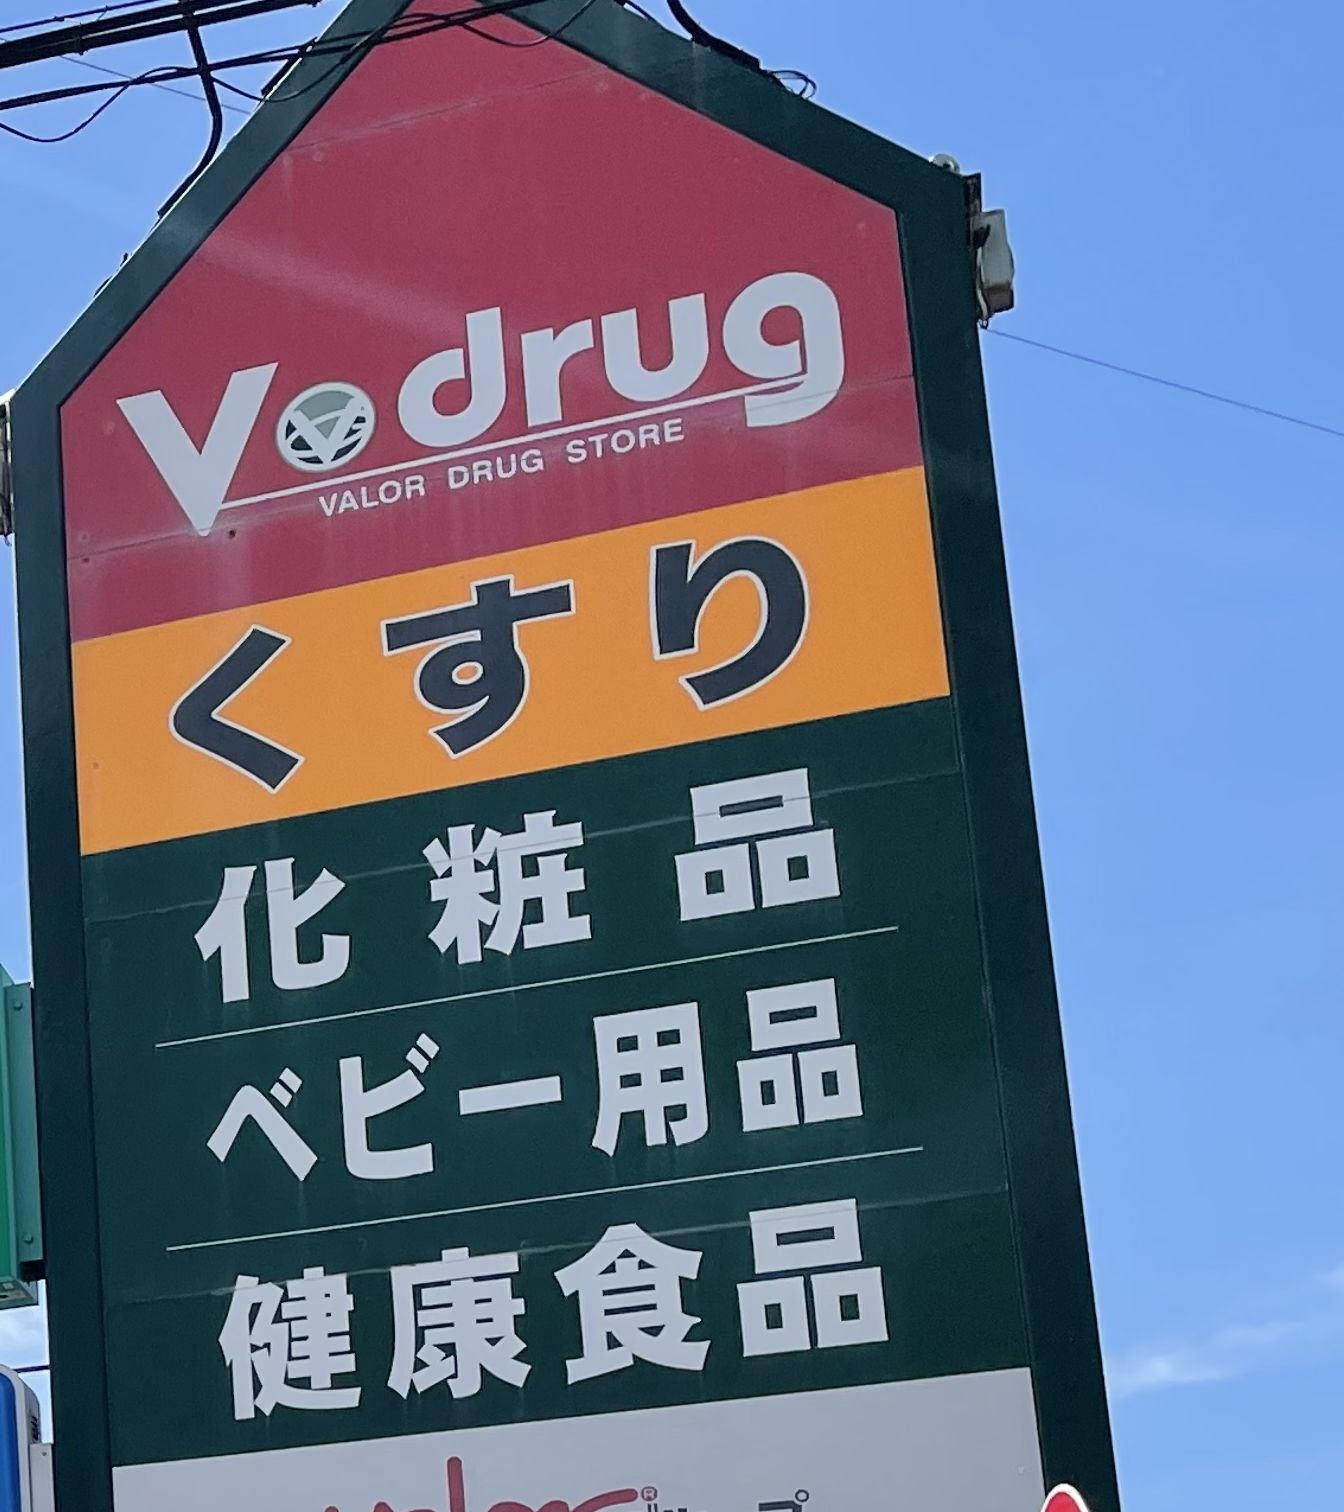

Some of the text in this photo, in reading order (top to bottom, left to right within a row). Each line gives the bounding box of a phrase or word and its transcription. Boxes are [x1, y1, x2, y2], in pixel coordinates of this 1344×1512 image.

[317, 417, 685, 518] VALOR DRUG STORE
[168, 535, 810, 793] くすり
[194, 768, 841, 1003] 化粧品
[206, 977, 863, 1181] ベビー用品
[218, 1197, 889, 1420] 健康食品
